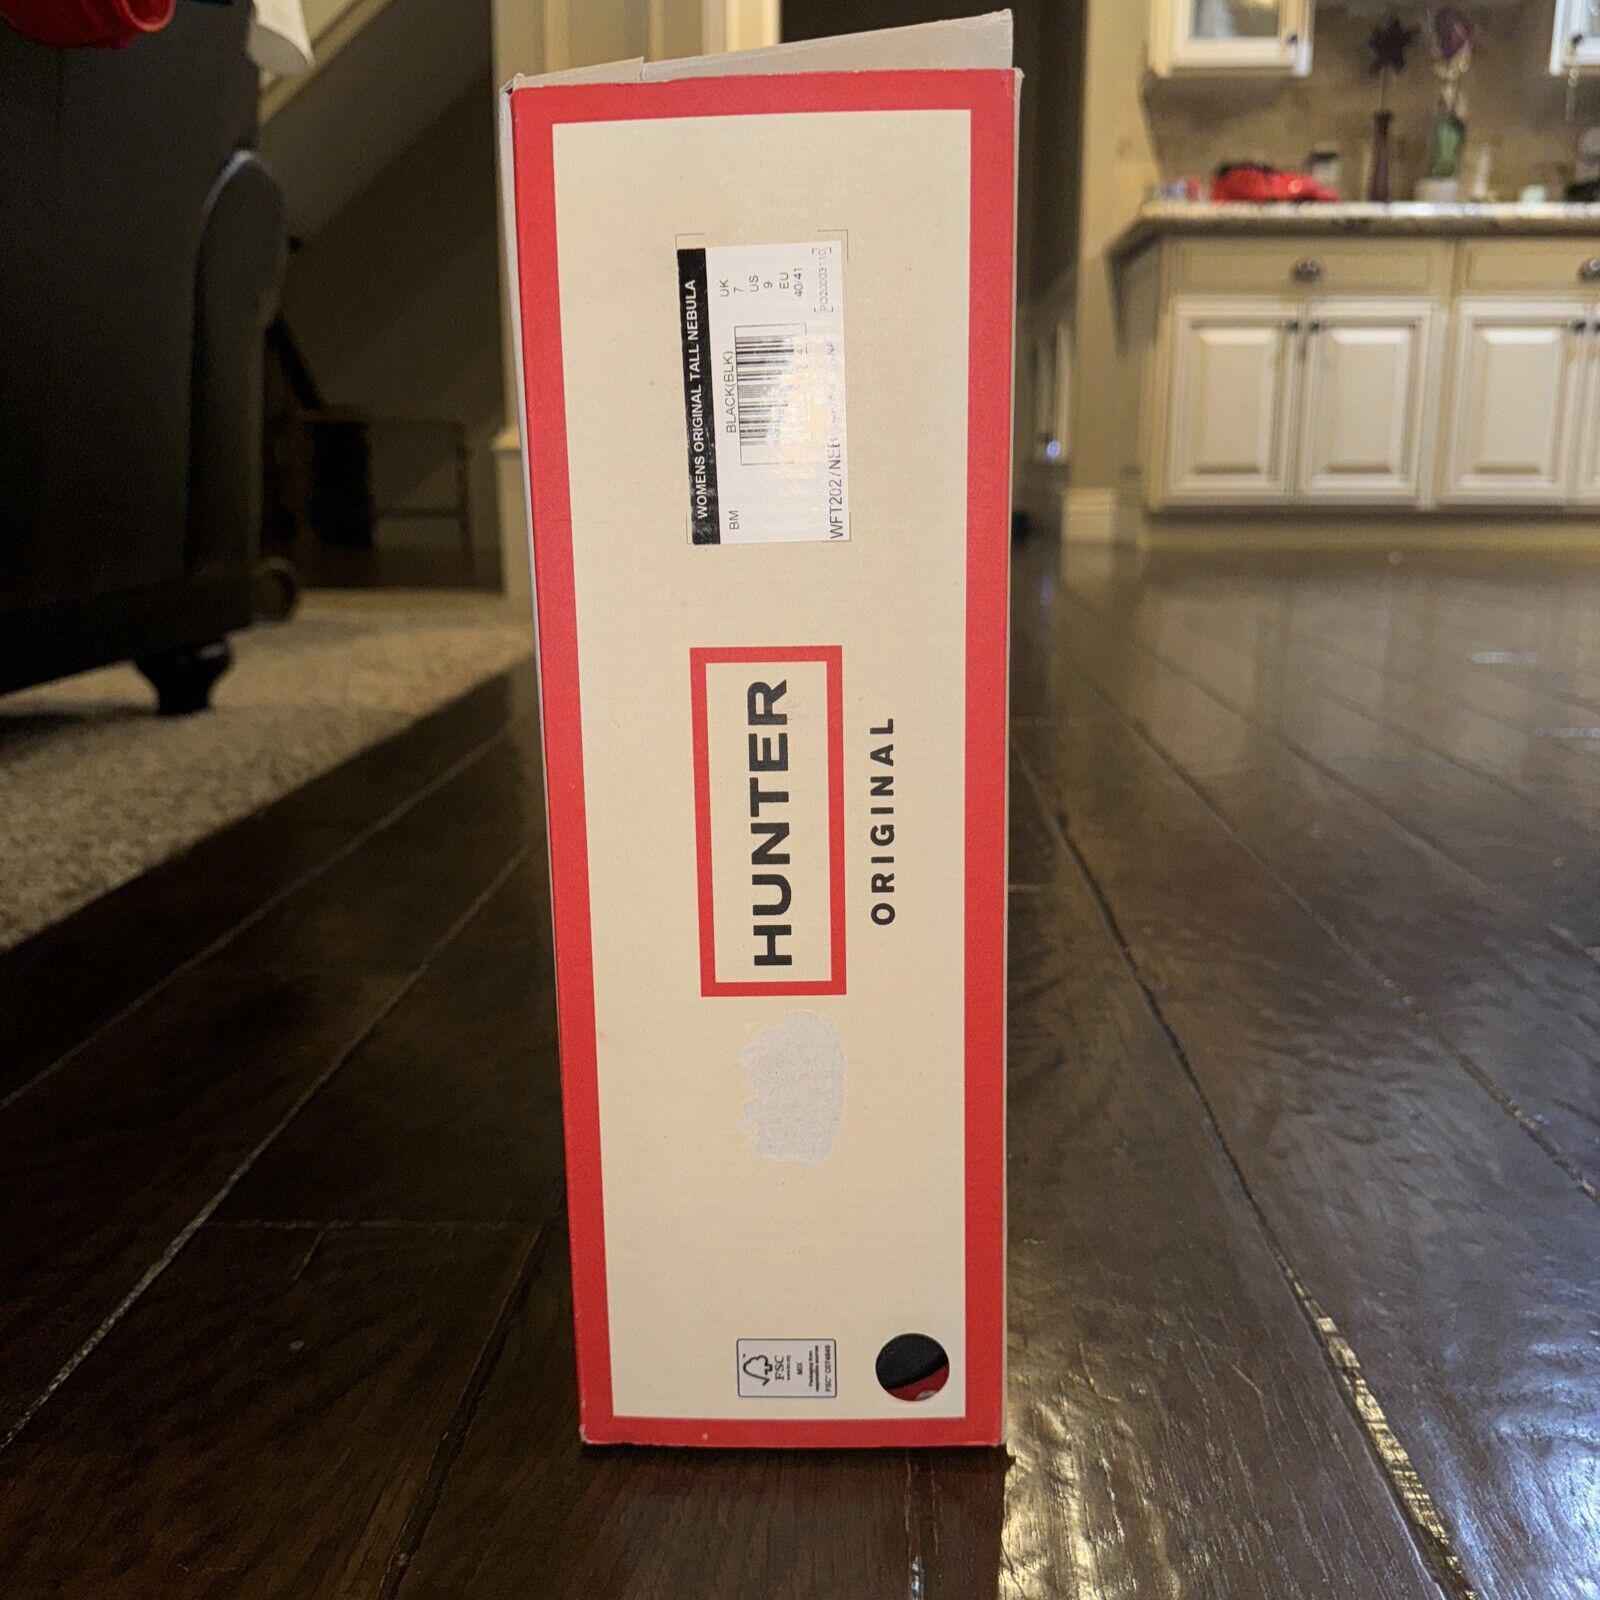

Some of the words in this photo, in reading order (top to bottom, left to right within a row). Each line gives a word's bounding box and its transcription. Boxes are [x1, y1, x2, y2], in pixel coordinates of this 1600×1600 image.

[719, 279, 730, 298] UK
[748, 275, 759, 293] US
[763, 281, 773, 289] 9
[779, 272, 790, 289] EU
[684, 279, 700, 343] NEBULA
[688, 343, 701, 381] TALL
[722, 351, 737, 433] BLACK(BLK)
[690, 384, 706, 453] ORIGINAL
[694, 455, 709, 520] WOMENS
[728, 509, 740, 530] BM
[747, 678, 793, 967] HUNTER
[869, 718, 896, 926] ORIGINAL
[774, 1355, 785, 1381] FSC
